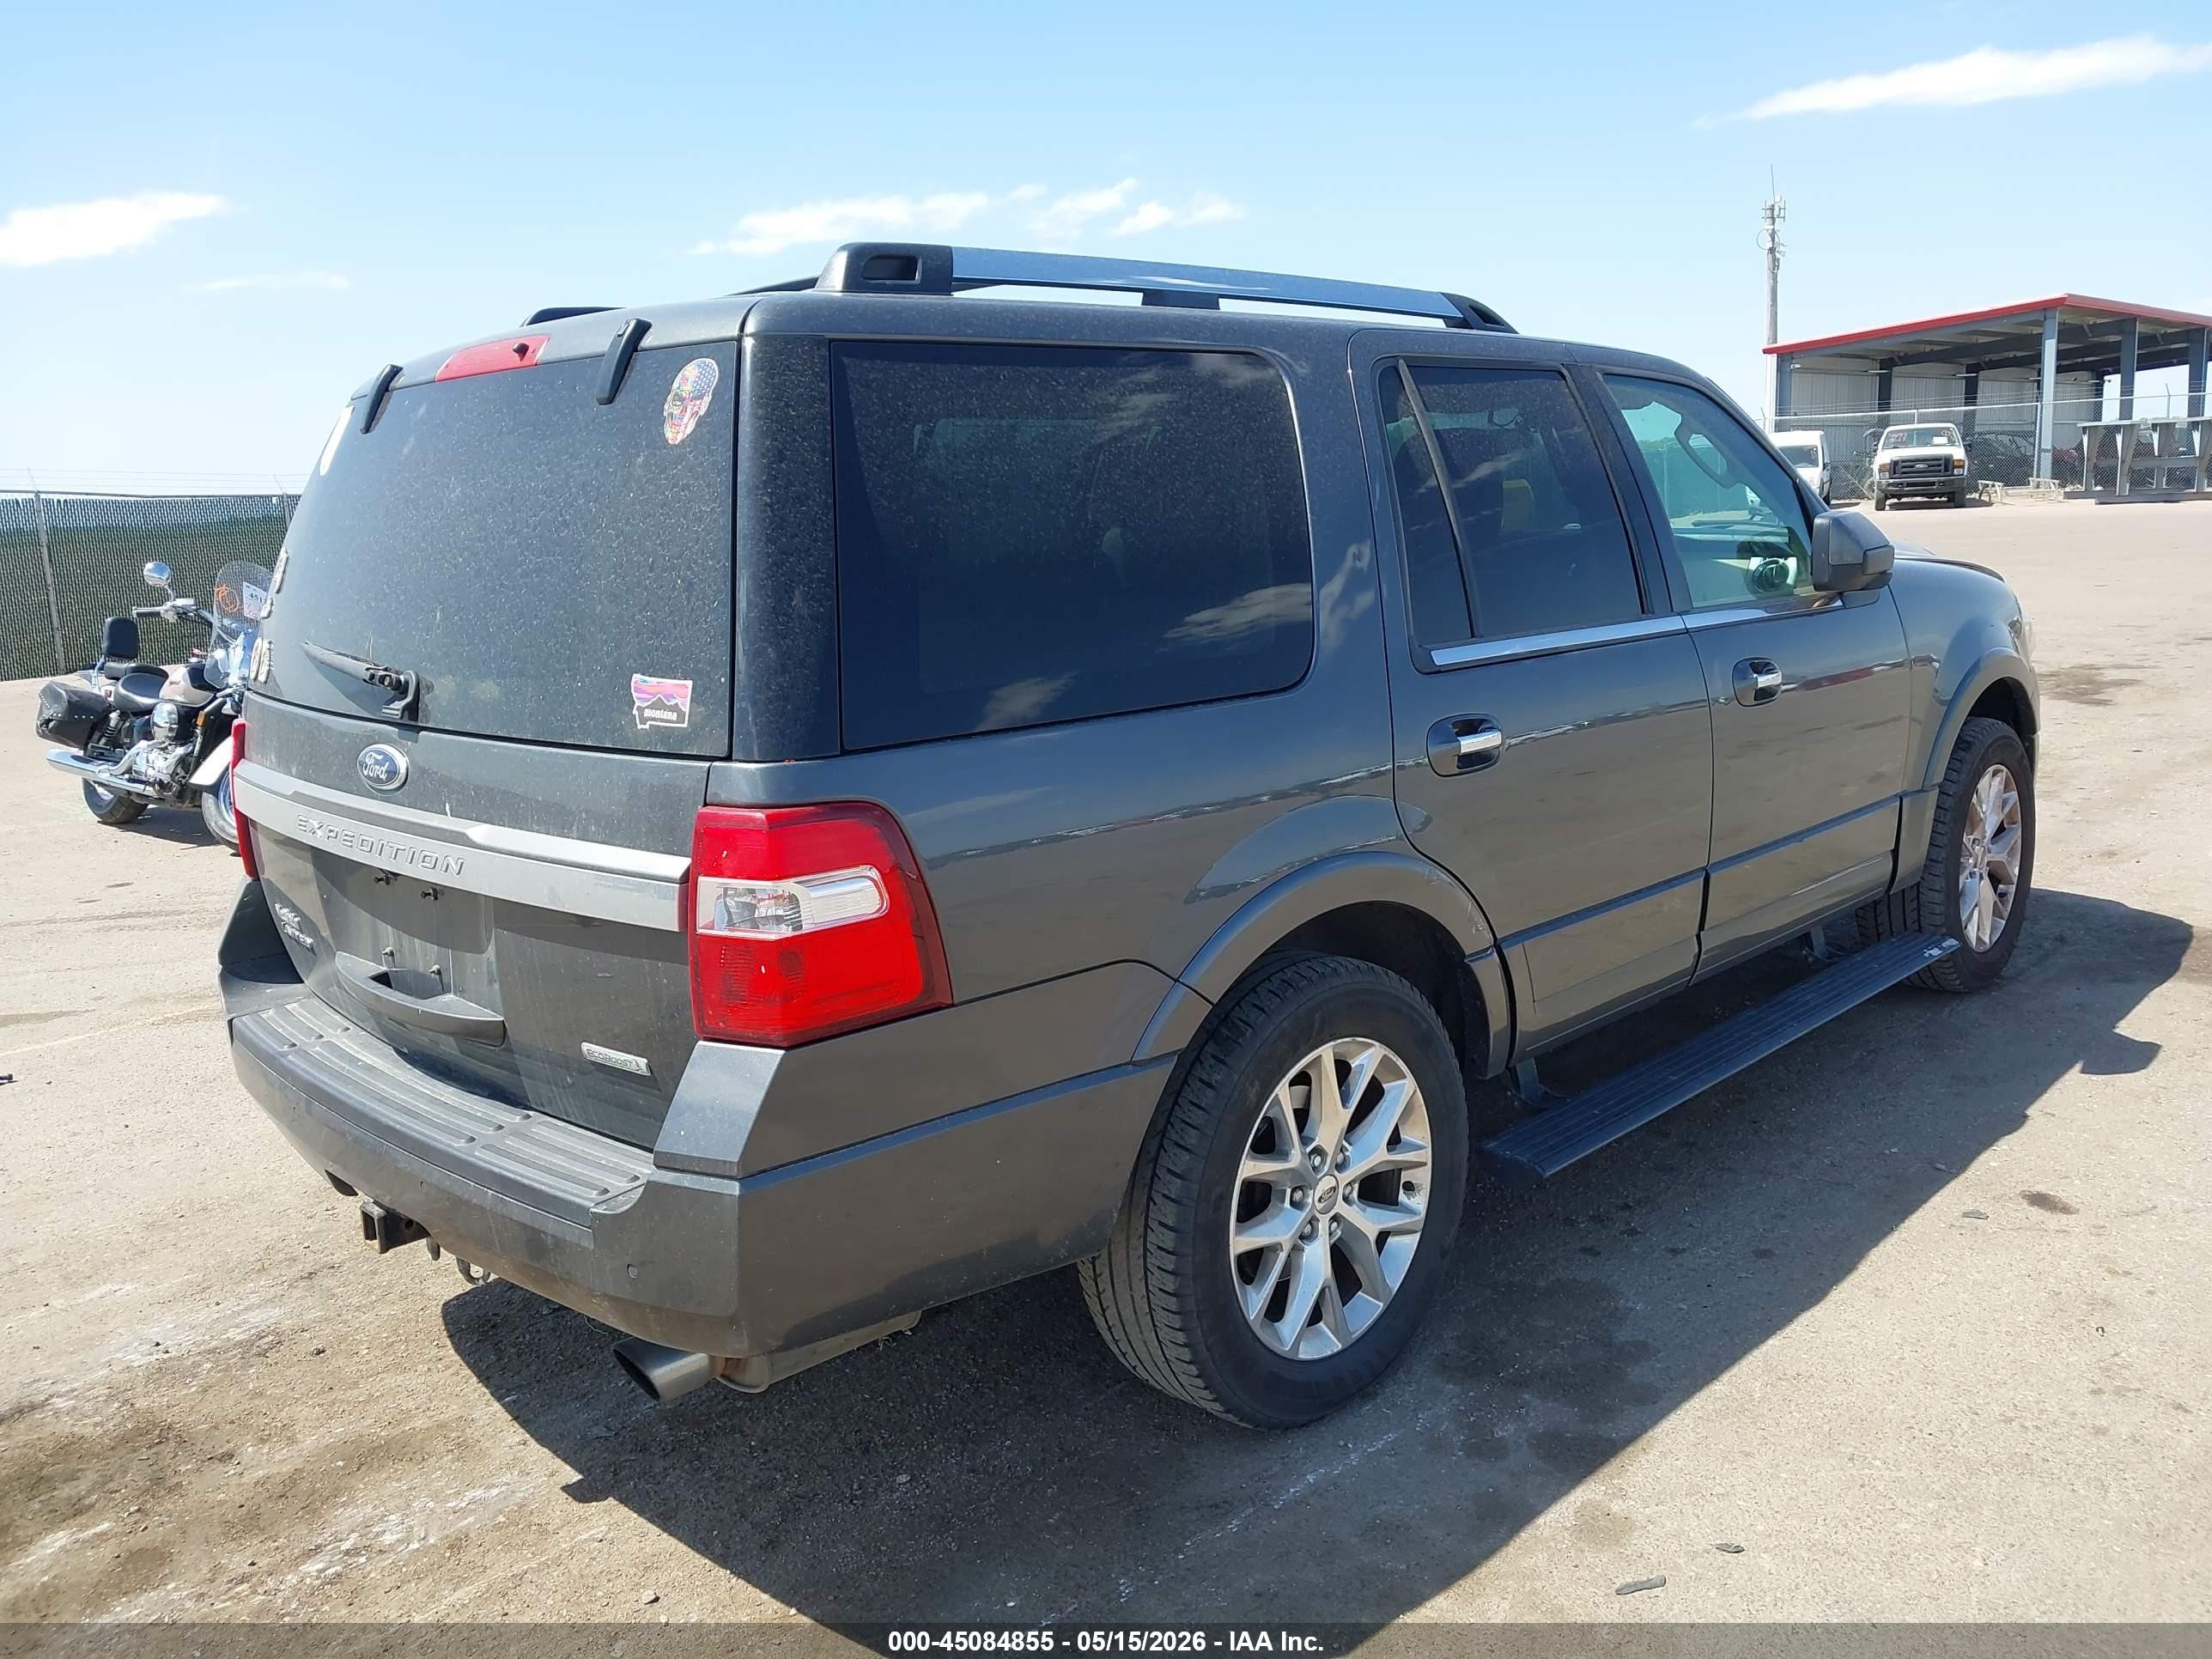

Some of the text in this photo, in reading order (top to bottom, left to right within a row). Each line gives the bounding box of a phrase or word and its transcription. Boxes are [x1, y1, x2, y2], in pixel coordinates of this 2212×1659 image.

[644, 708, 678, 720] montana
[362, 751, 390, 781] Ford
[295, 814, 465, 878] EXPEDITION
